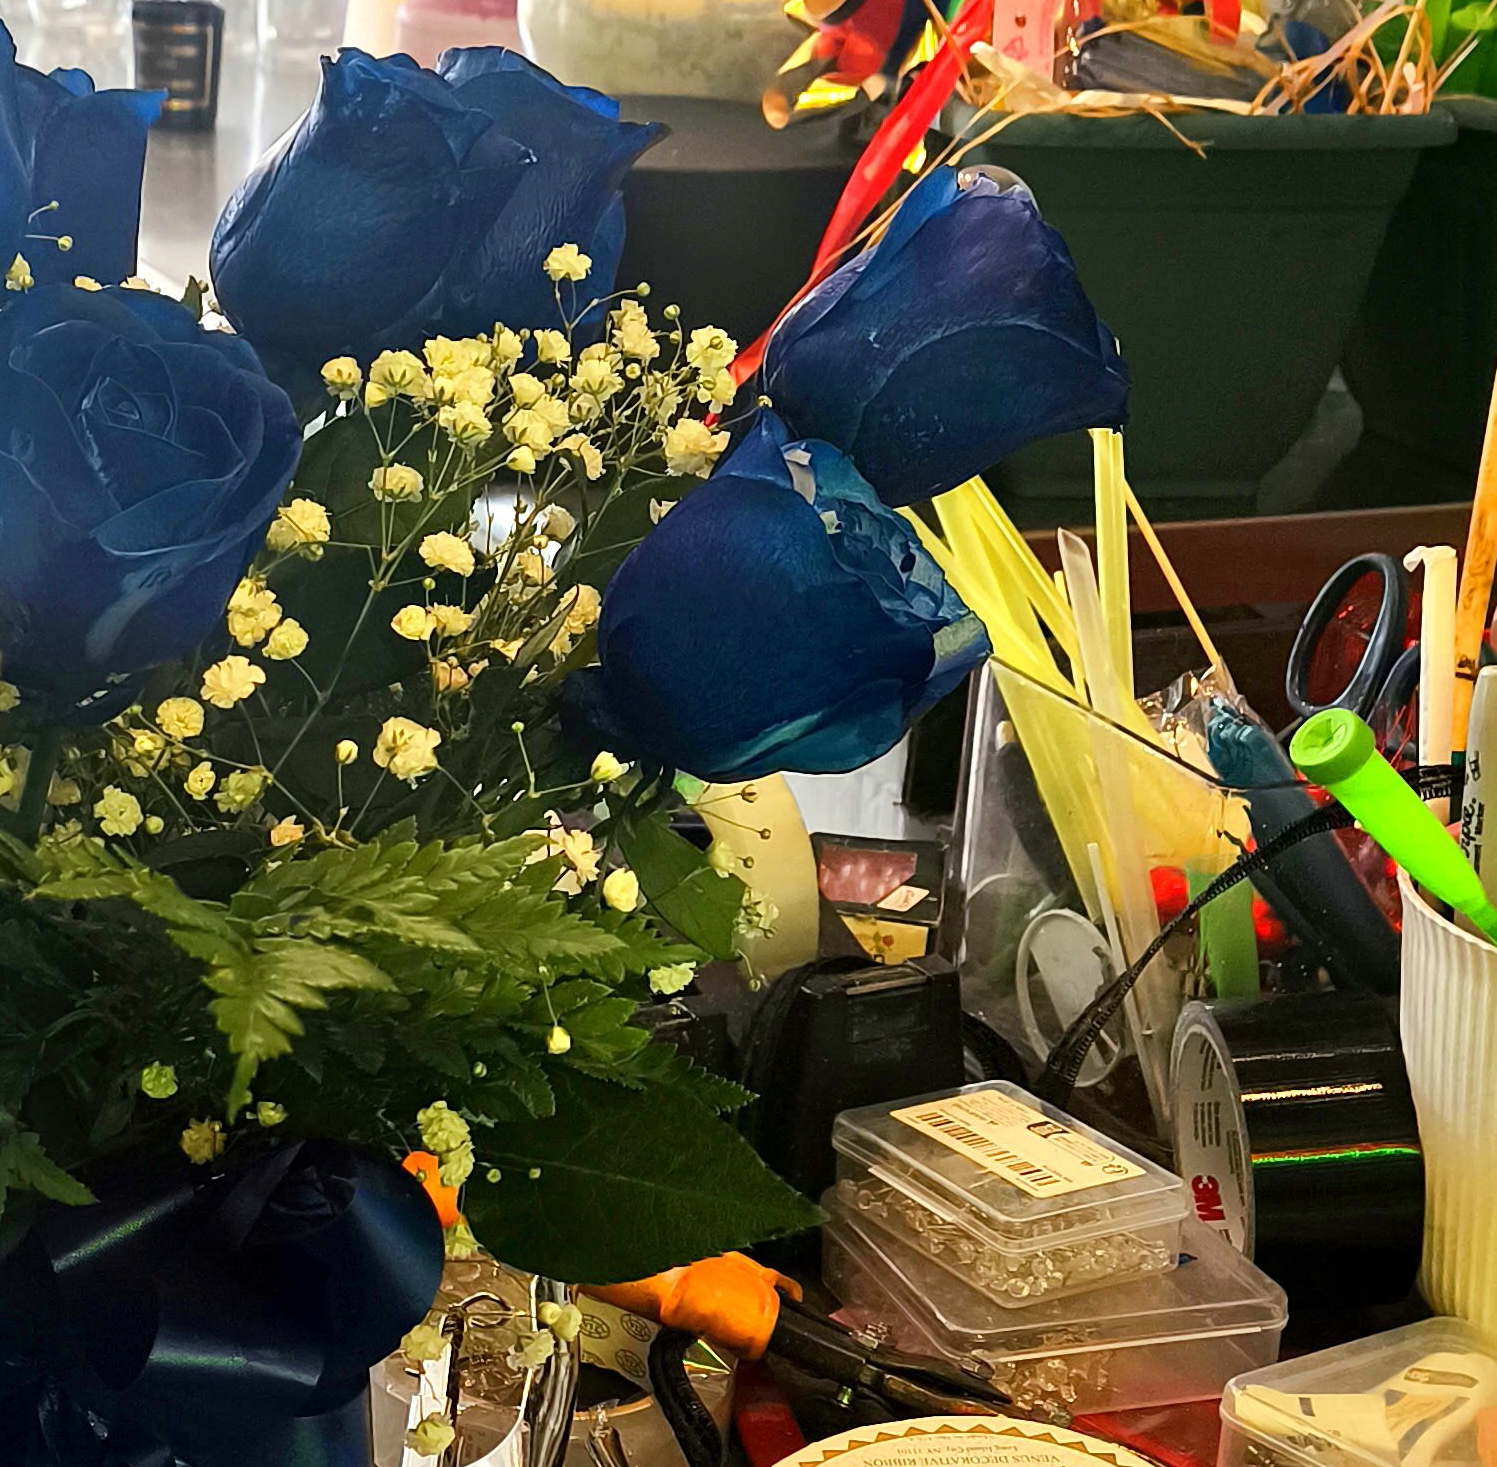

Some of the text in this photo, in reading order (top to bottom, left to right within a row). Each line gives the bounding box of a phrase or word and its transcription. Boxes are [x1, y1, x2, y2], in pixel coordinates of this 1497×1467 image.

[1192, 1175, 1225, 1222] 3M
[863, 1454, 1059, 1467] VENUS DECORATIVE RIBBON
